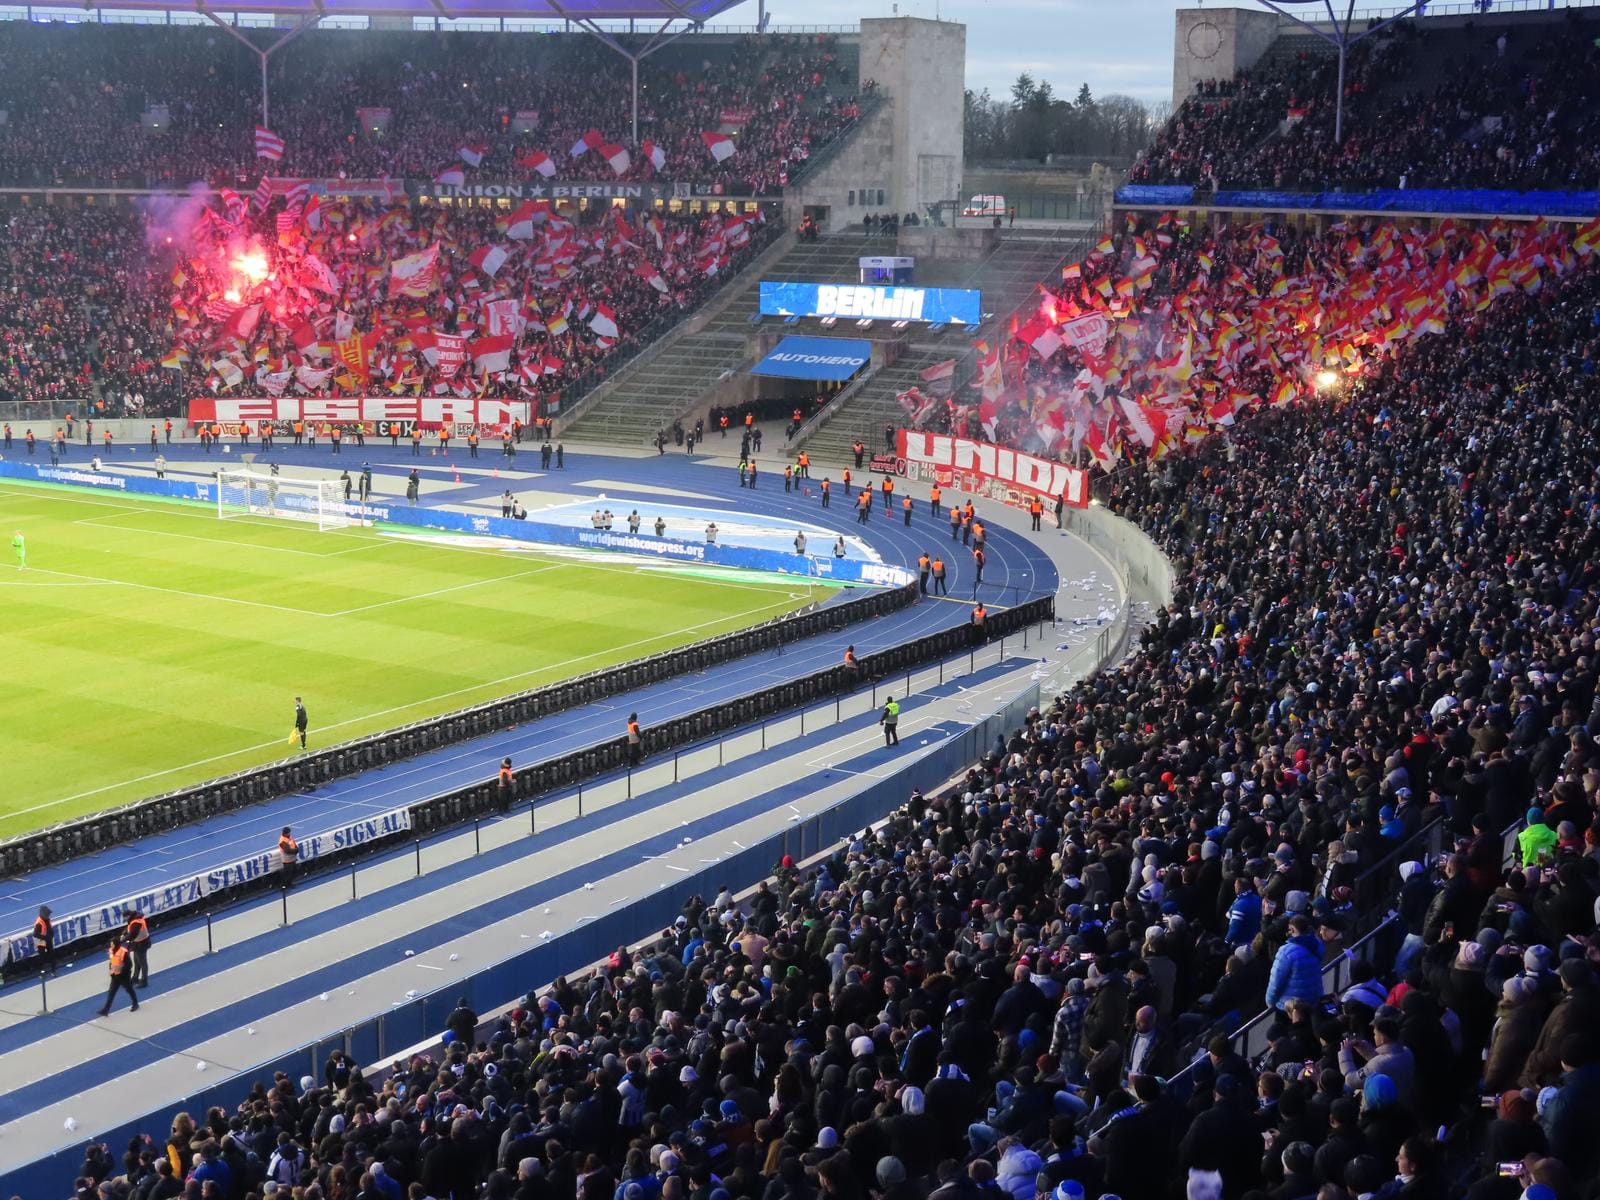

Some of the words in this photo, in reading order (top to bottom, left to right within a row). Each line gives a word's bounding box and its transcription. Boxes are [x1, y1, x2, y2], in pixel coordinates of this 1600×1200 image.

[434, 185, 523, 198] UNION
[552, 185, 642, 198] BERLIN
[769, 352, 864, 366] AUTOHERO
[215, 400, 531, 425] EISERN
[37, 469, 126, 489] worldjewishcongress.org
[906, 432, 1083, 503] UNION
[578, 531, 705, 560] worldjewishcongress.org
[207, 853, 273, 891] START
[333, 810, 409, 849] SIGNAL!
